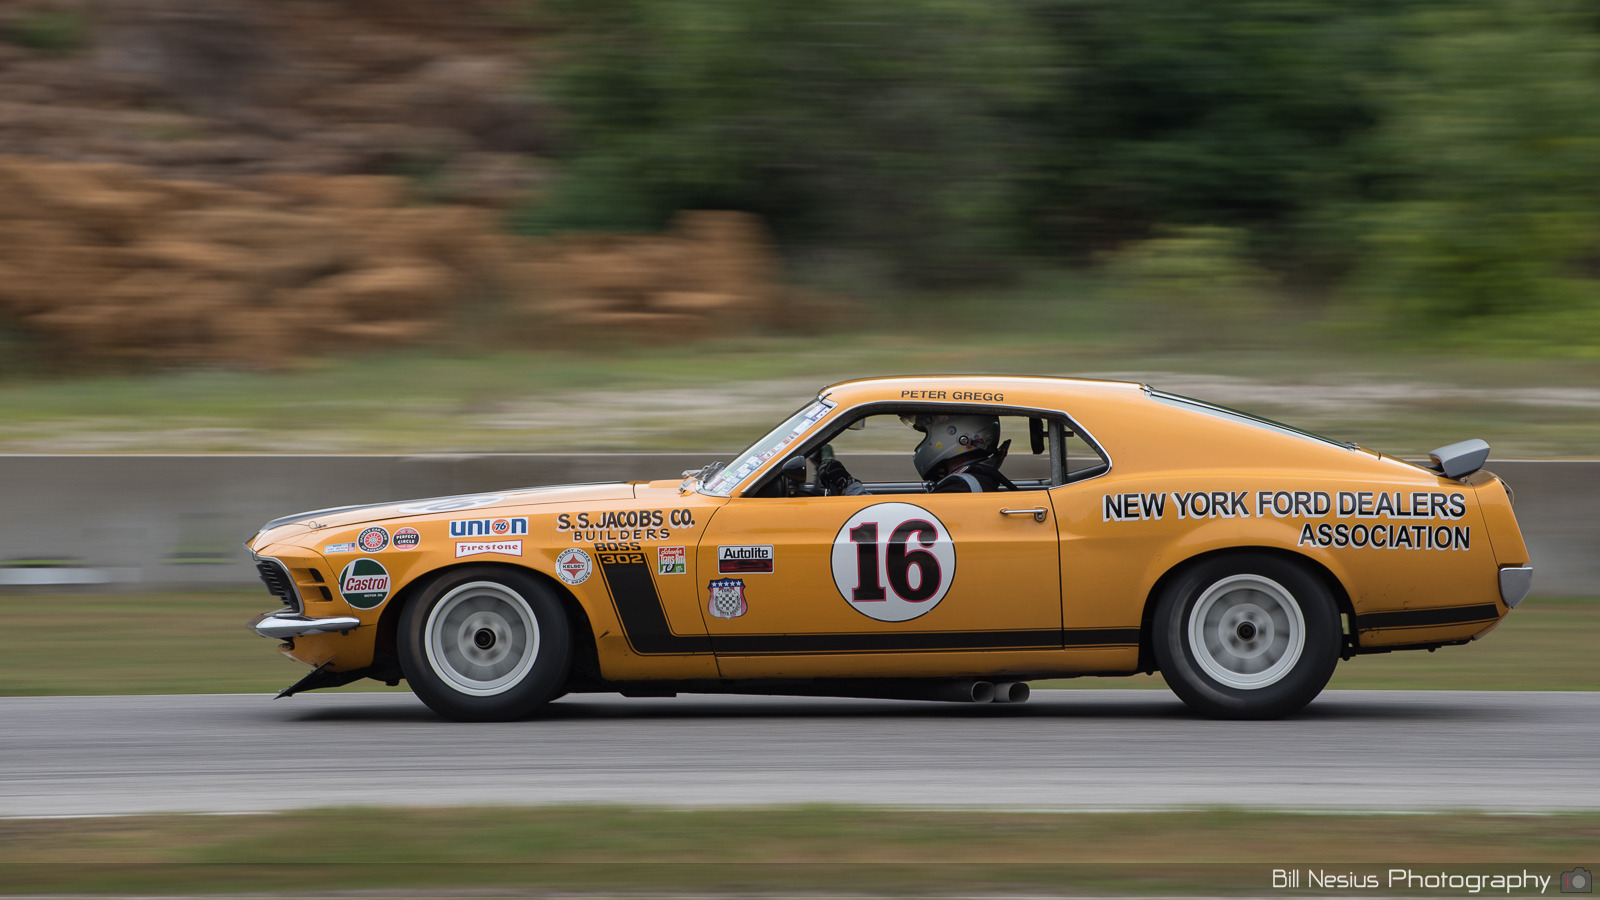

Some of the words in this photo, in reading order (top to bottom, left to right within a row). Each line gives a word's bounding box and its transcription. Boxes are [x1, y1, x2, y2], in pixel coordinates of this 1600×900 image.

[901, 390, 946, 399] PETER
[952, 391, 1004, 402] GREGG
[1103, 492, 1167, 522] NEW
[1170, 491, 1250, 520] YORK
[1256, 491, 1331, 519] FORD
[1336, 491, 1466, 520] DEALERS
[669, 509, 696, 529] CO.
[495, 521, 507, 531] 76
[573, 529, 670, 542] BUILDERS
[1297, 522, 1470, 551] ASSOCIATION
[460, 544, 519, 553] Firestone
[594, 542, 642, 551] BOSS
[601, 554, 644, 564] 302
[724, 547, 769, 559] Autolite
[849, 518, 942, 603] 16
[345, 577, 388, 591] Castrol
